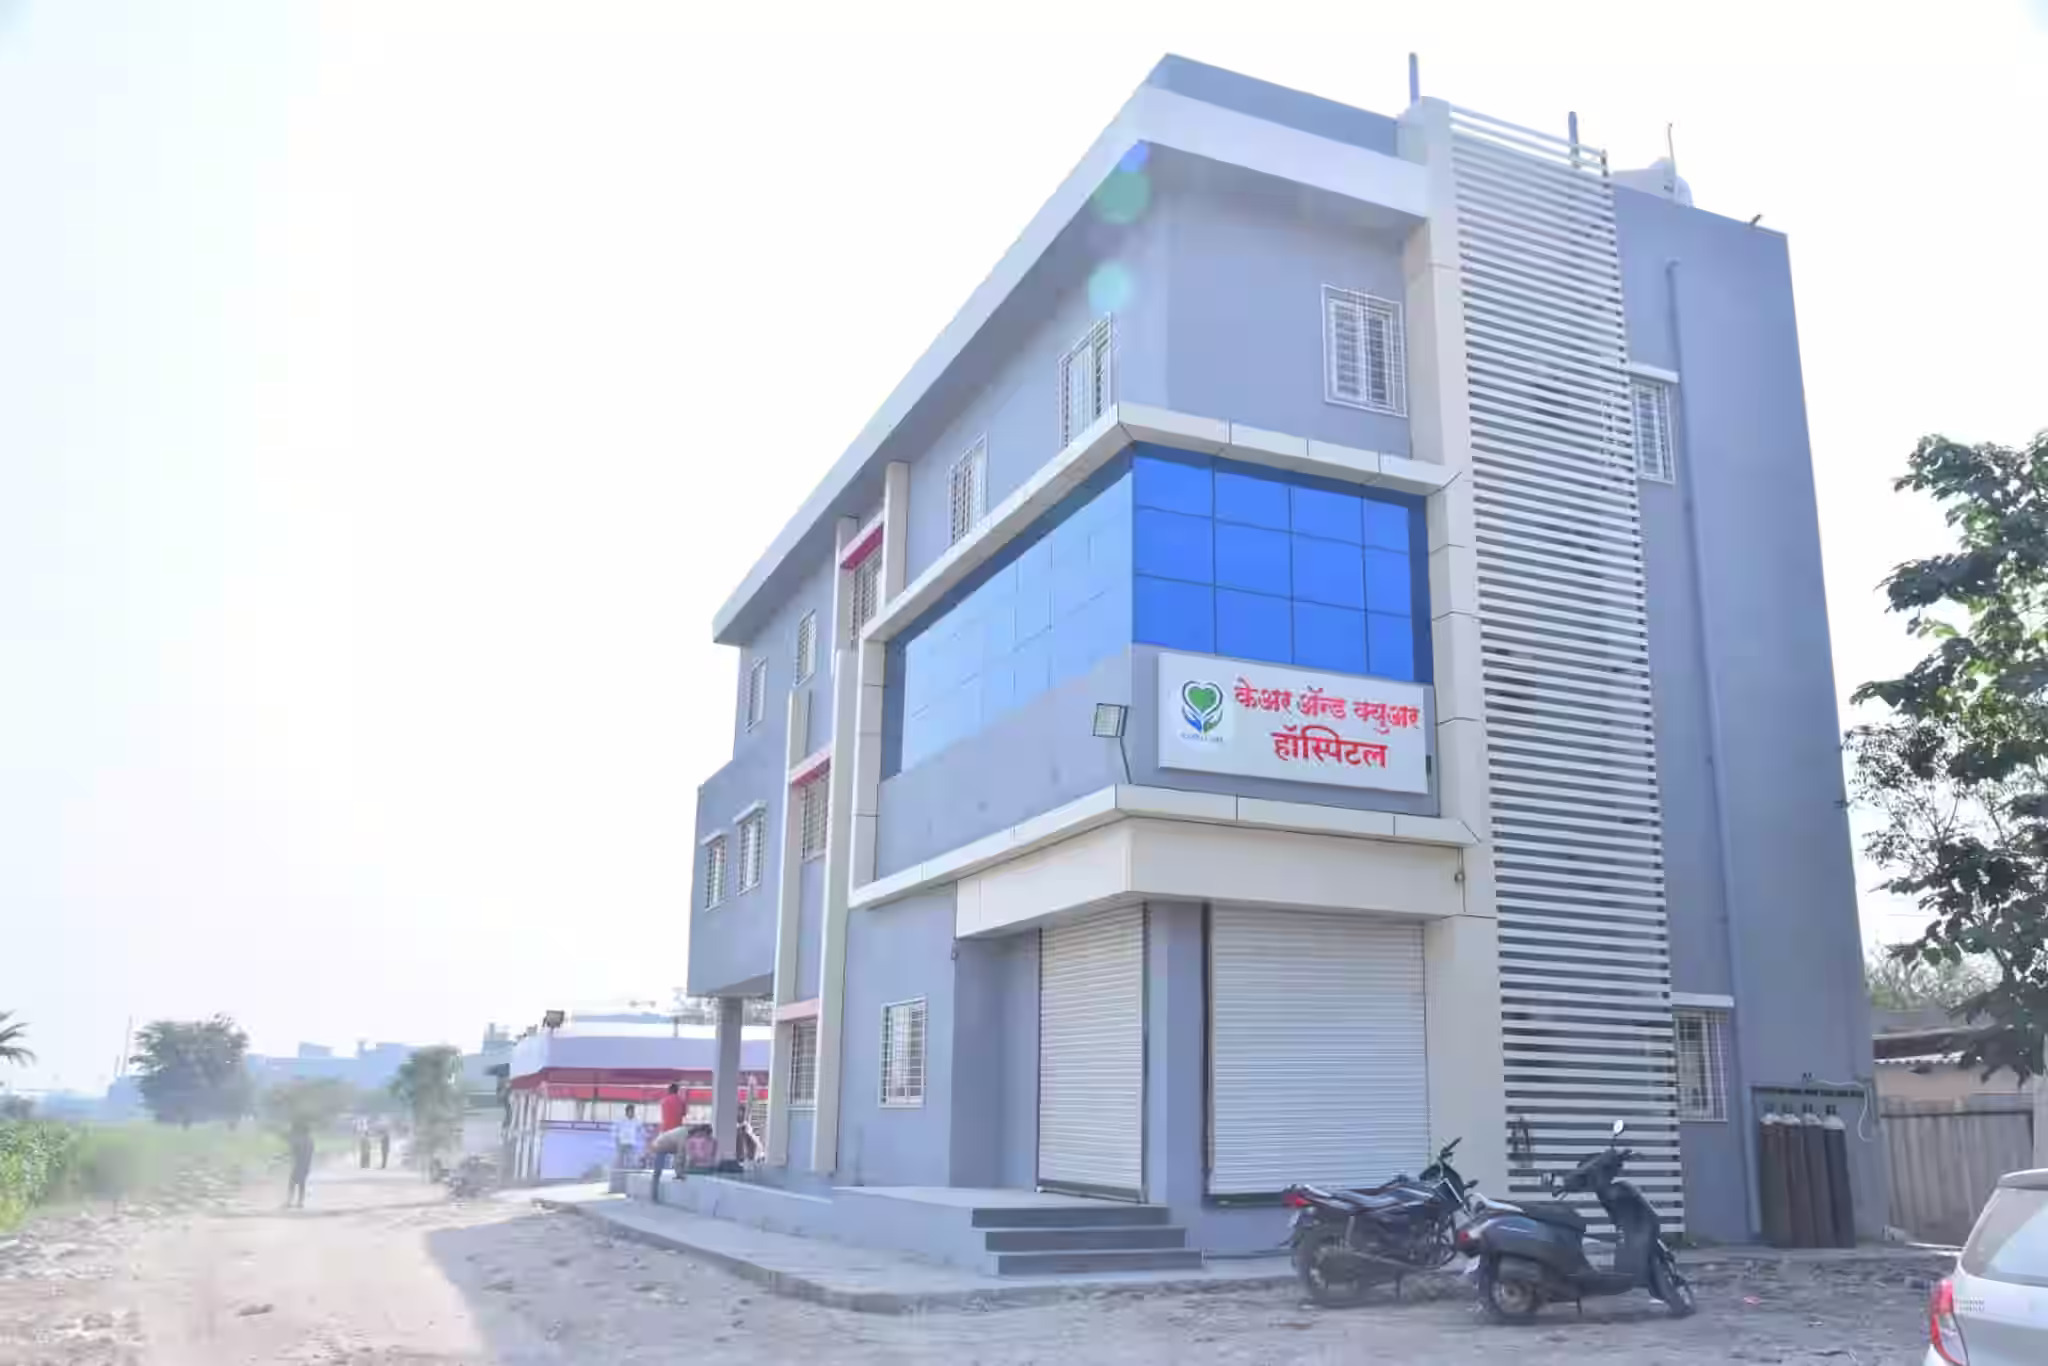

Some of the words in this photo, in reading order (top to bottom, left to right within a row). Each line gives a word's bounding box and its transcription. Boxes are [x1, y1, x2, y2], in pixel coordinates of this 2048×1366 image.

[1234, 676, 1293, 714] केअर
[1353, 699, 1420, 735] क्युअर
[1271, 724, 1389, 768] हॉस्पिटल
